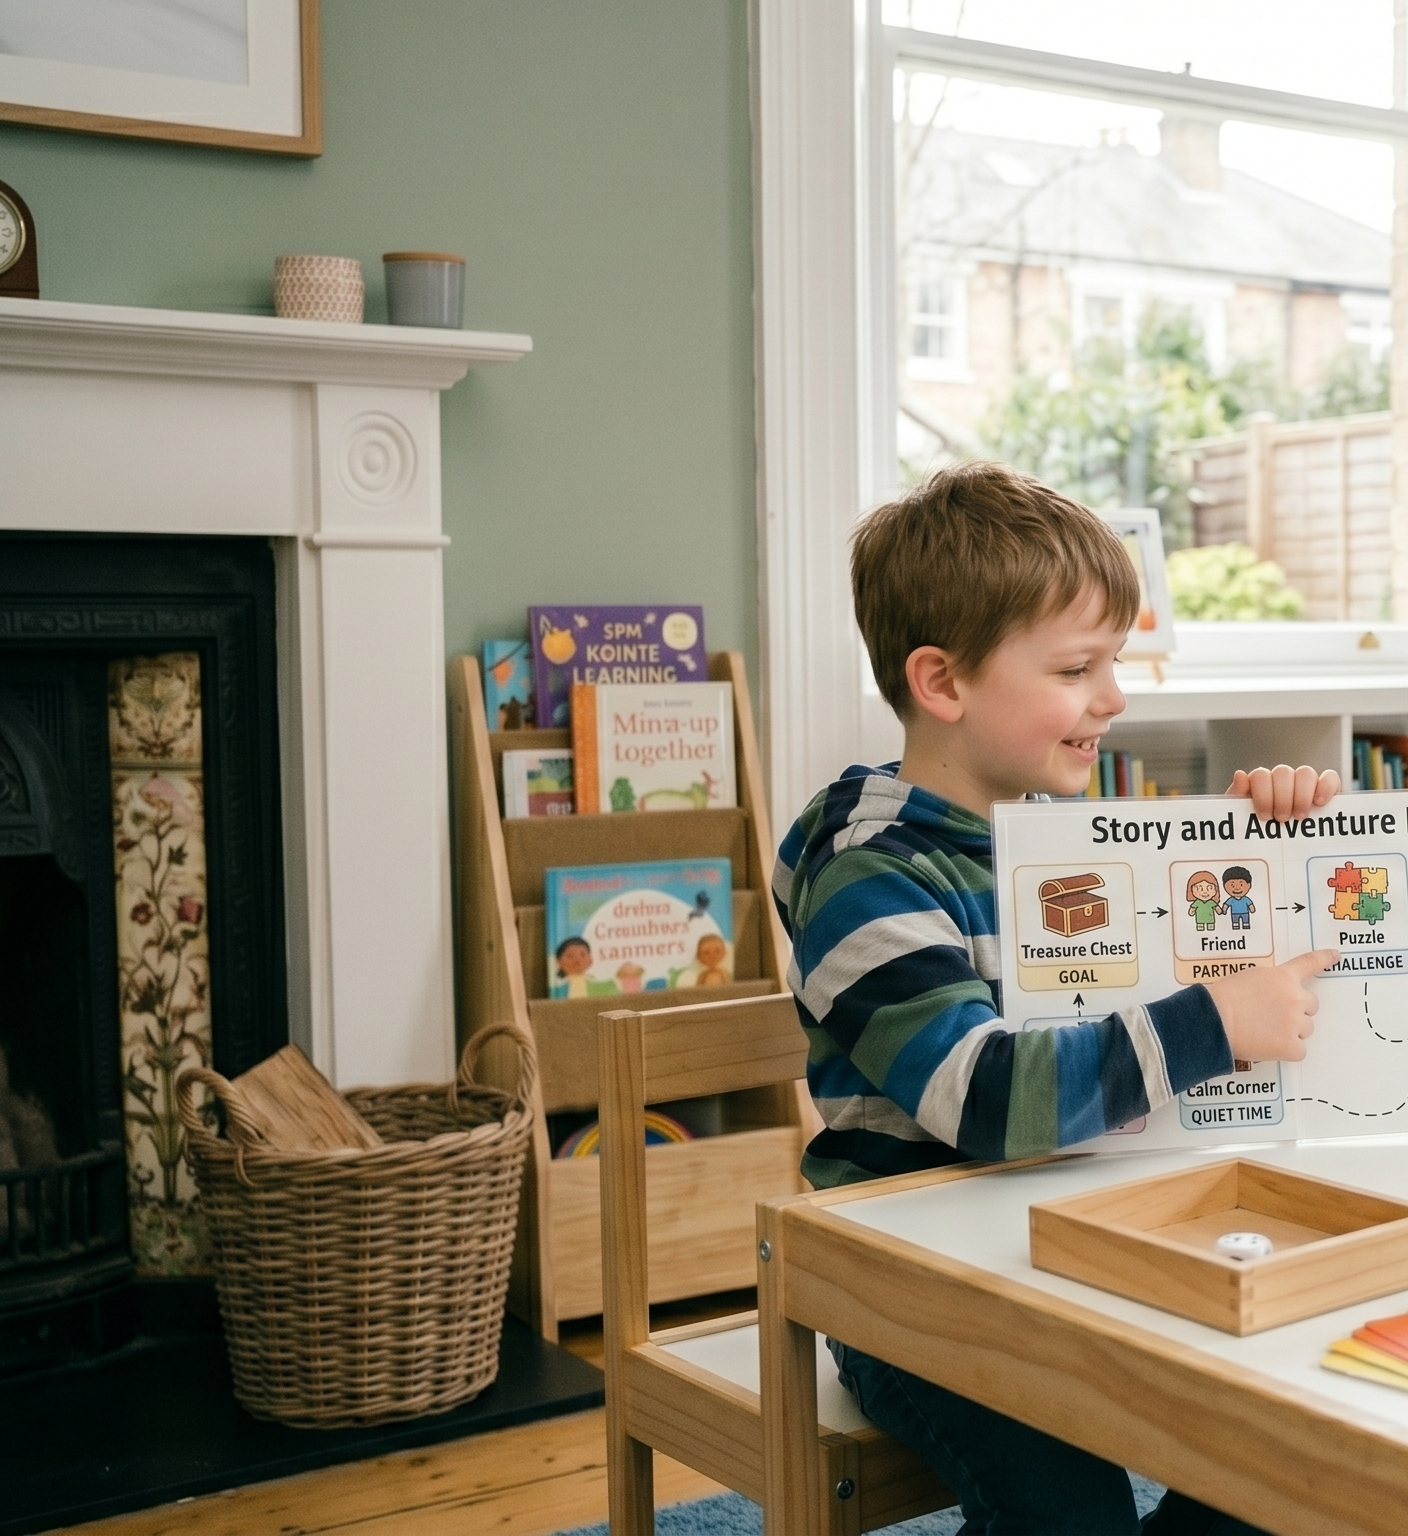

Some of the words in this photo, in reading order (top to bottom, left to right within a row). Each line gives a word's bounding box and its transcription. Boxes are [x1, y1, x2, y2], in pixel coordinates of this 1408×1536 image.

[603, 622, 642, 640] SPM
[586, 644, 660, 663] KOINTE
[573, 666, 677, 685] LEARNING
[614, 738, 716, 767] together
[1092, 816, 1171, 850] Story
[1181, 812, 1235, 841] and
[1245, 810, 1396, 840] Adventure
[1201, 936, 1246, 951] Friend
[1339, 929, 1385, 945] Puzzle
[1021, 943, 1087, 959] Treasure
[1091, 941, 1132, 956] Chest
[1323, 955, 1404, 972] HALLENGE
[1059, 969, 1098, 984] GOAL
[1187, 1082, 1222, 1097] Calm
[1226, 1080, 1276, 1095] Corner
[1191, 1108, 1234, 1125] QUIET
[1238, 1106, 1272, 1120] TIME
